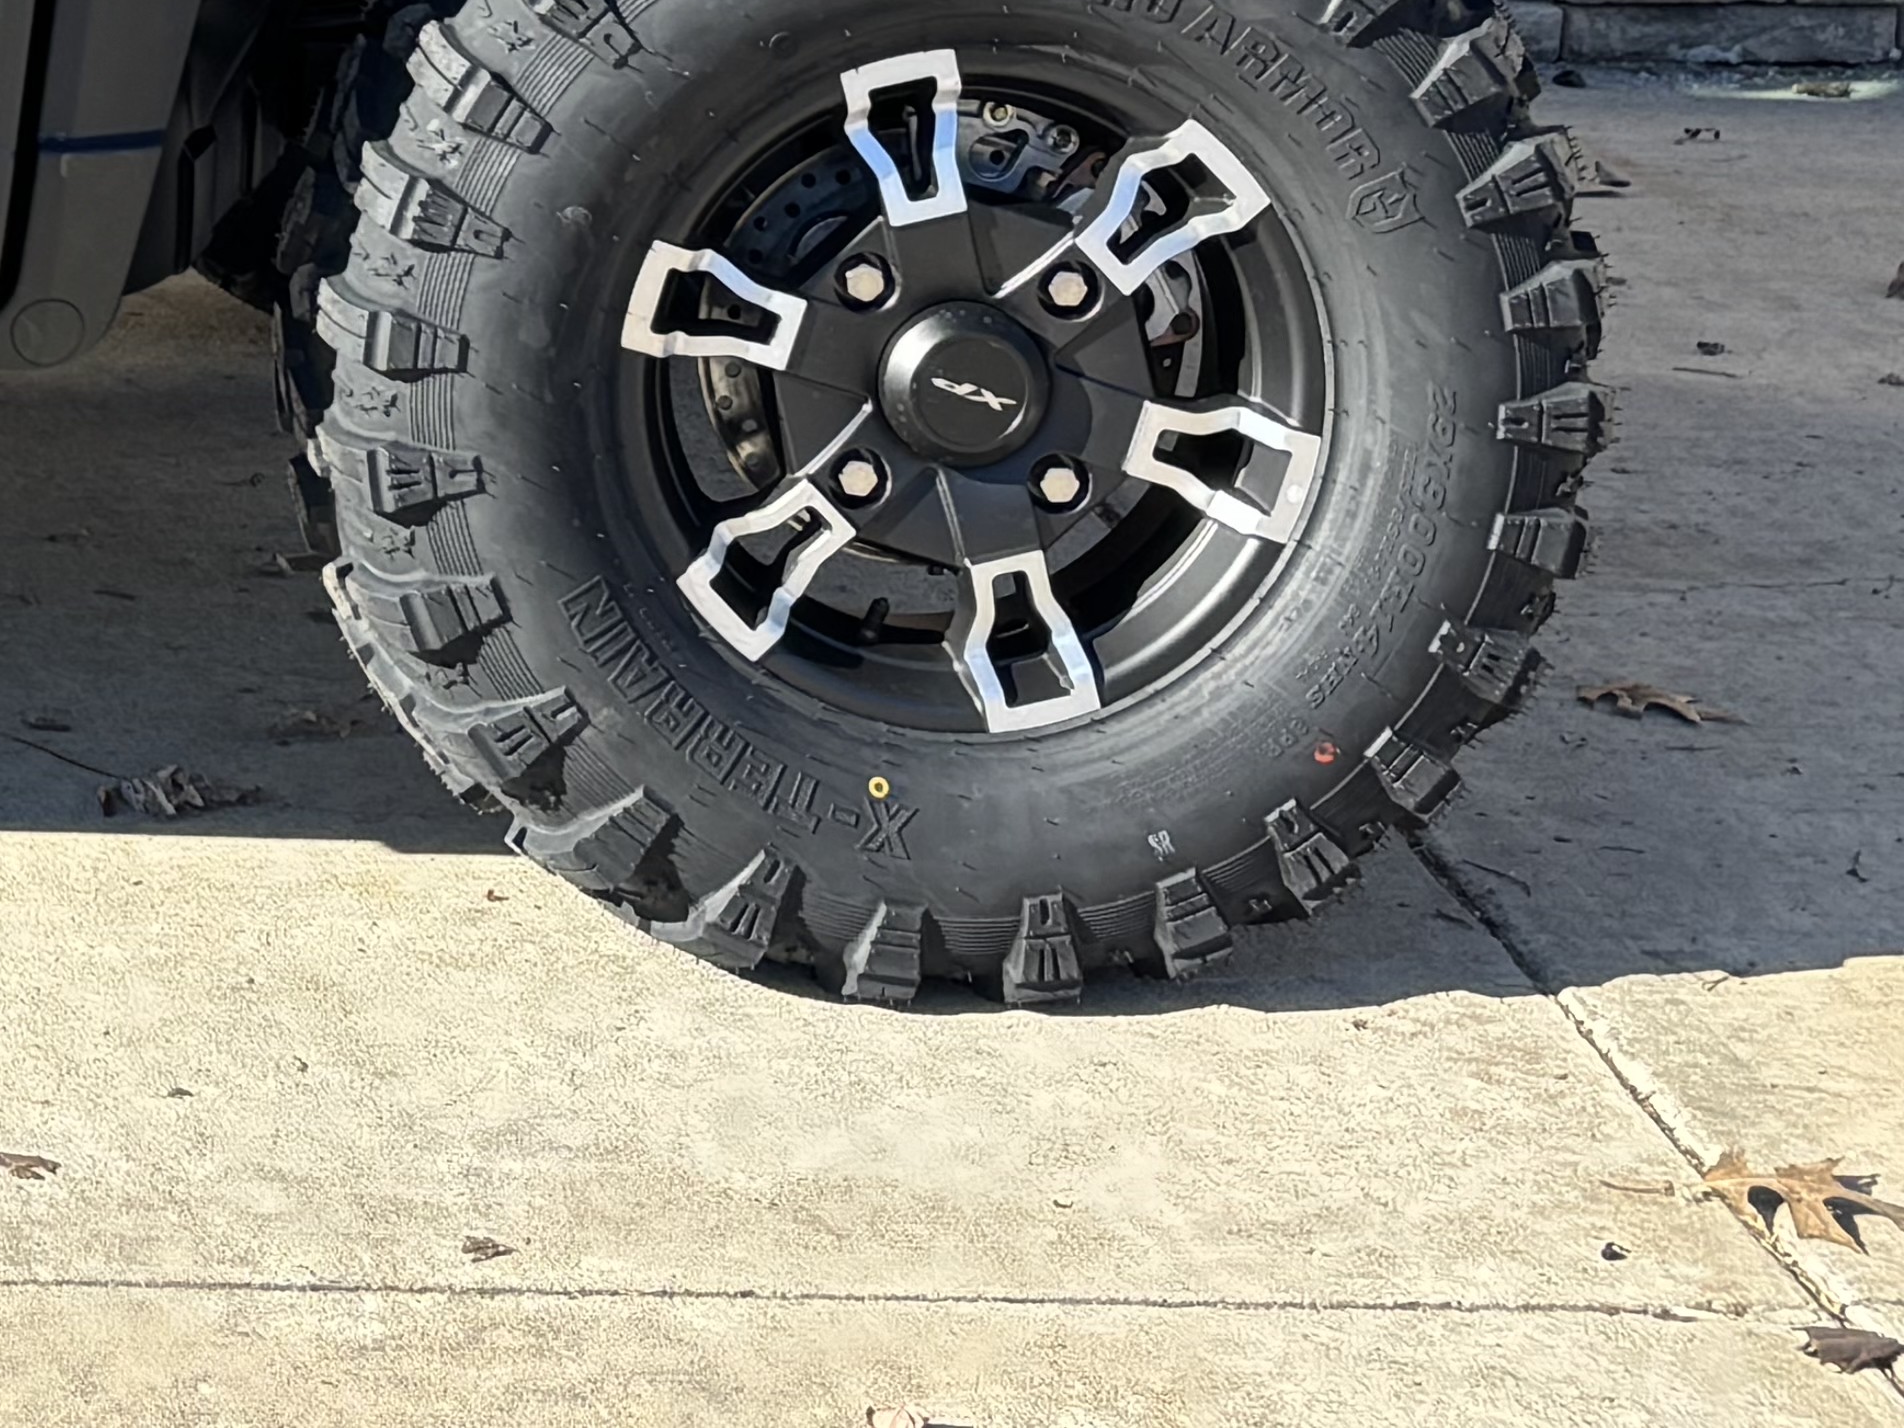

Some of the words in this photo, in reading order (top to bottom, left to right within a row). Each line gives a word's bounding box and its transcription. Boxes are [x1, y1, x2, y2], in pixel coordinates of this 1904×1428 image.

[1180, 2, 1381, 181] ARMOR
[930, 376, 1018, 412] XP
[557, 574, 921, 861] X-TERRAIN
